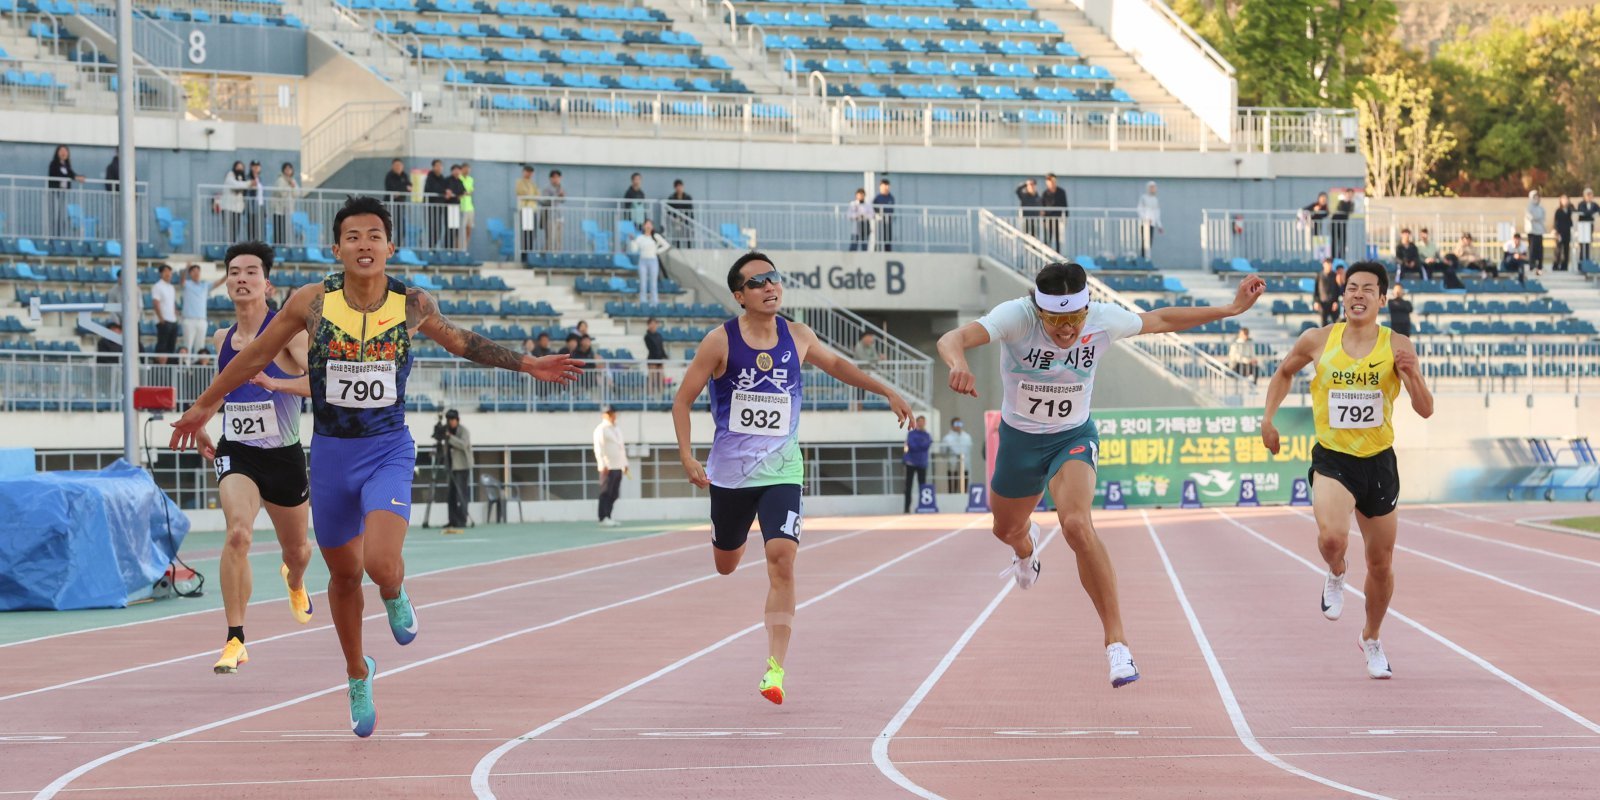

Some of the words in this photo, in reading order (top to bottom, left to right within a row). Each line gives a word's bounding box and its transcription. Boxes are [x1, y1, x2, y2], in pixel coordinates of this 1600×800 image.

[189, 30, 206, 64] 8
[828, 266, 876, 289] Gate
[886, 261, 905, 294] B
[1023, 348, 1054, 370] 서울
[1064, 345, 1095, 369] 시청
[1332, 371, 1379, 385] 안양시청
[339, 380, 384, 401] 790
[1029, 397, 1072, 417] 719
[1338, 405, 1374, 422] 792
[232, 417, 265, 434] 921
[741, 408, 781, 429] 932
[1096, 419, 1117, 434] 과
[1121, 418, 1151, 434] 멋이
[1155, 417, 1202, 434] 가득한
[1206, 416, 1237, 433] 낭만
[1130, 438, 1174, 464] 메카!
[1180, 437, 1230, 463] 스포츠
[921, 488, 933, 505] 8
[971, 487, 983, 504] 7
[1109, 484, 1121, 502] 5
[1184, 483, 1196, 501] 4
[1242, 481, 1254, 499] 3
[1295, 481, 1307, 499] 2
[792, 515, 801, 537] 6
